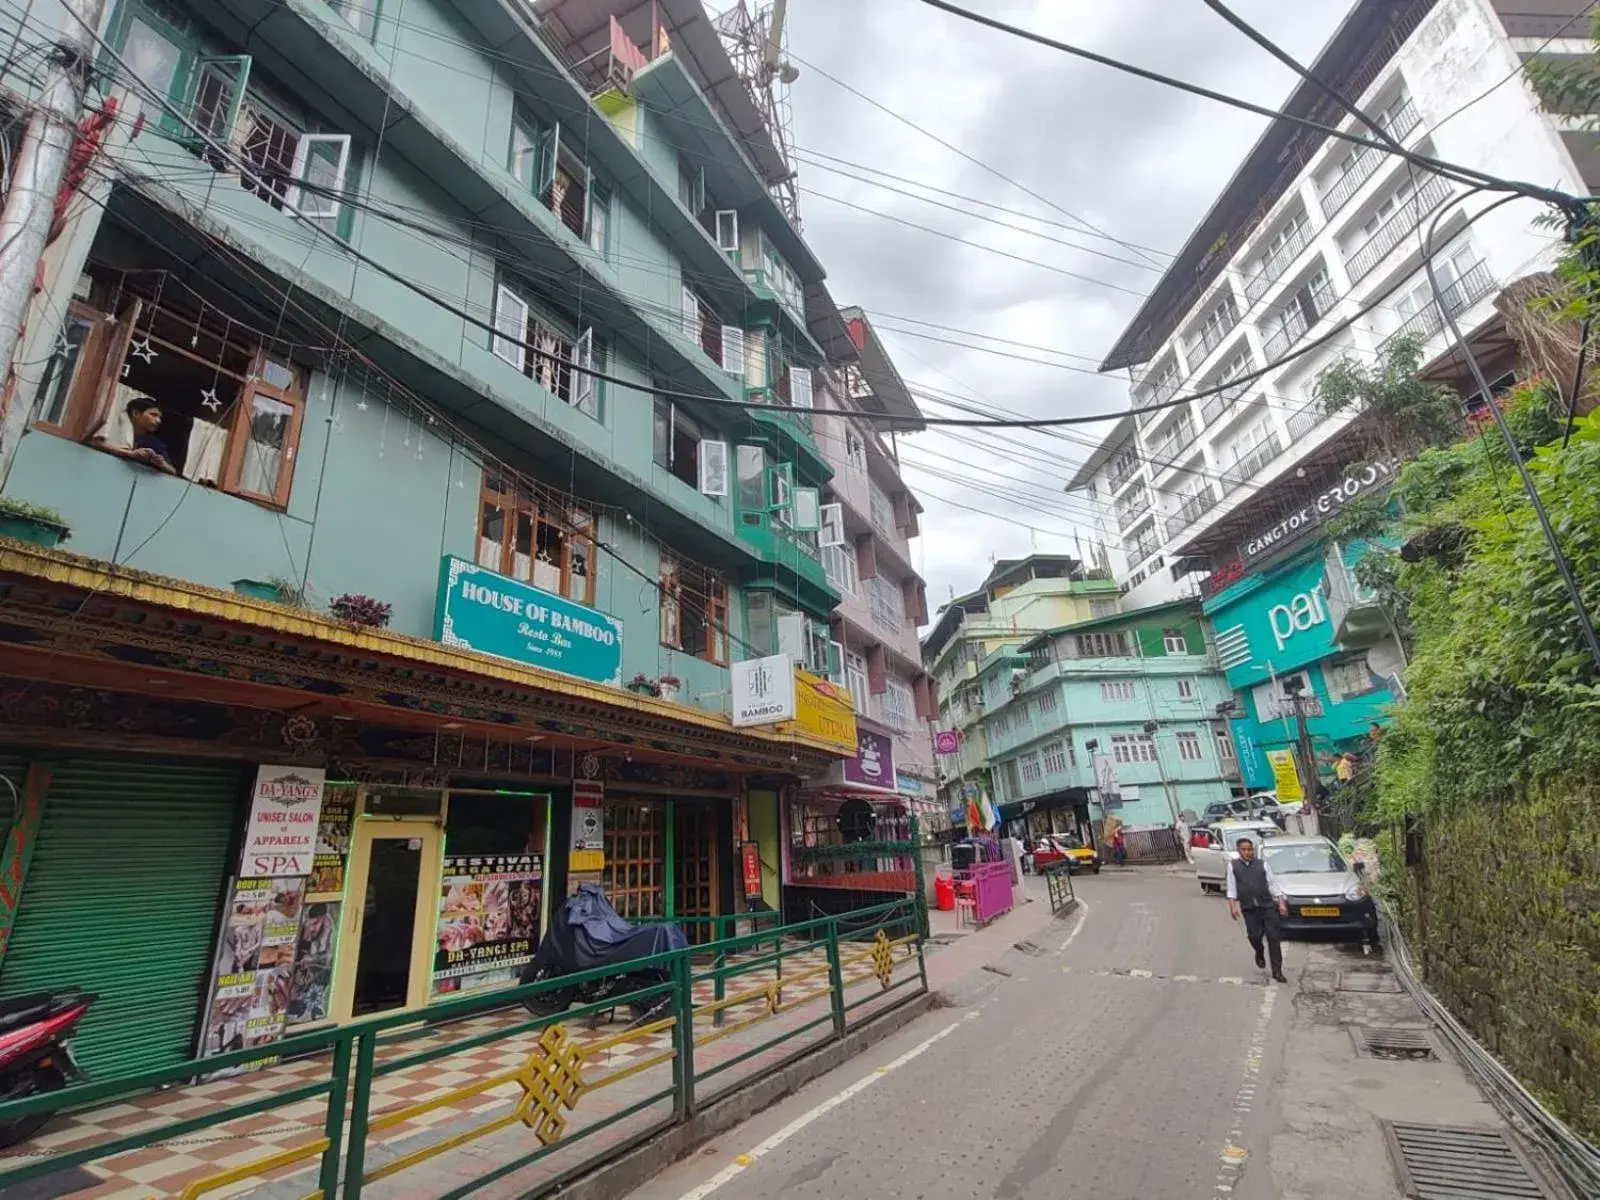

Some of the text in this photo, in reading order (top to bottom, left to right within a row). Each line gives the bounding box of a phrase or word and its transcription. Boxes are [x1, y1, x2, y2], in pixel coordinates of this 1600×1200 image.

[1248, 509, 1310, 556] GANGTOK
[462, 580, 614, 646] HOUSE OF BAMBOO
[517, 622, 549, 641] Resto
[740, 705, 784, 718] BAMBOO
[257, 812, 286, 822] UNISEX
[288, 812, 313, 822] SALON
[253, 836, 310, 846] APPARELS
[254, 856, 300, 876] SPA
[443, 856, 540, 866] FESTIVAL
[443, 865, 491, 875] MEGA
[510, 940, 529, 953] SPA
